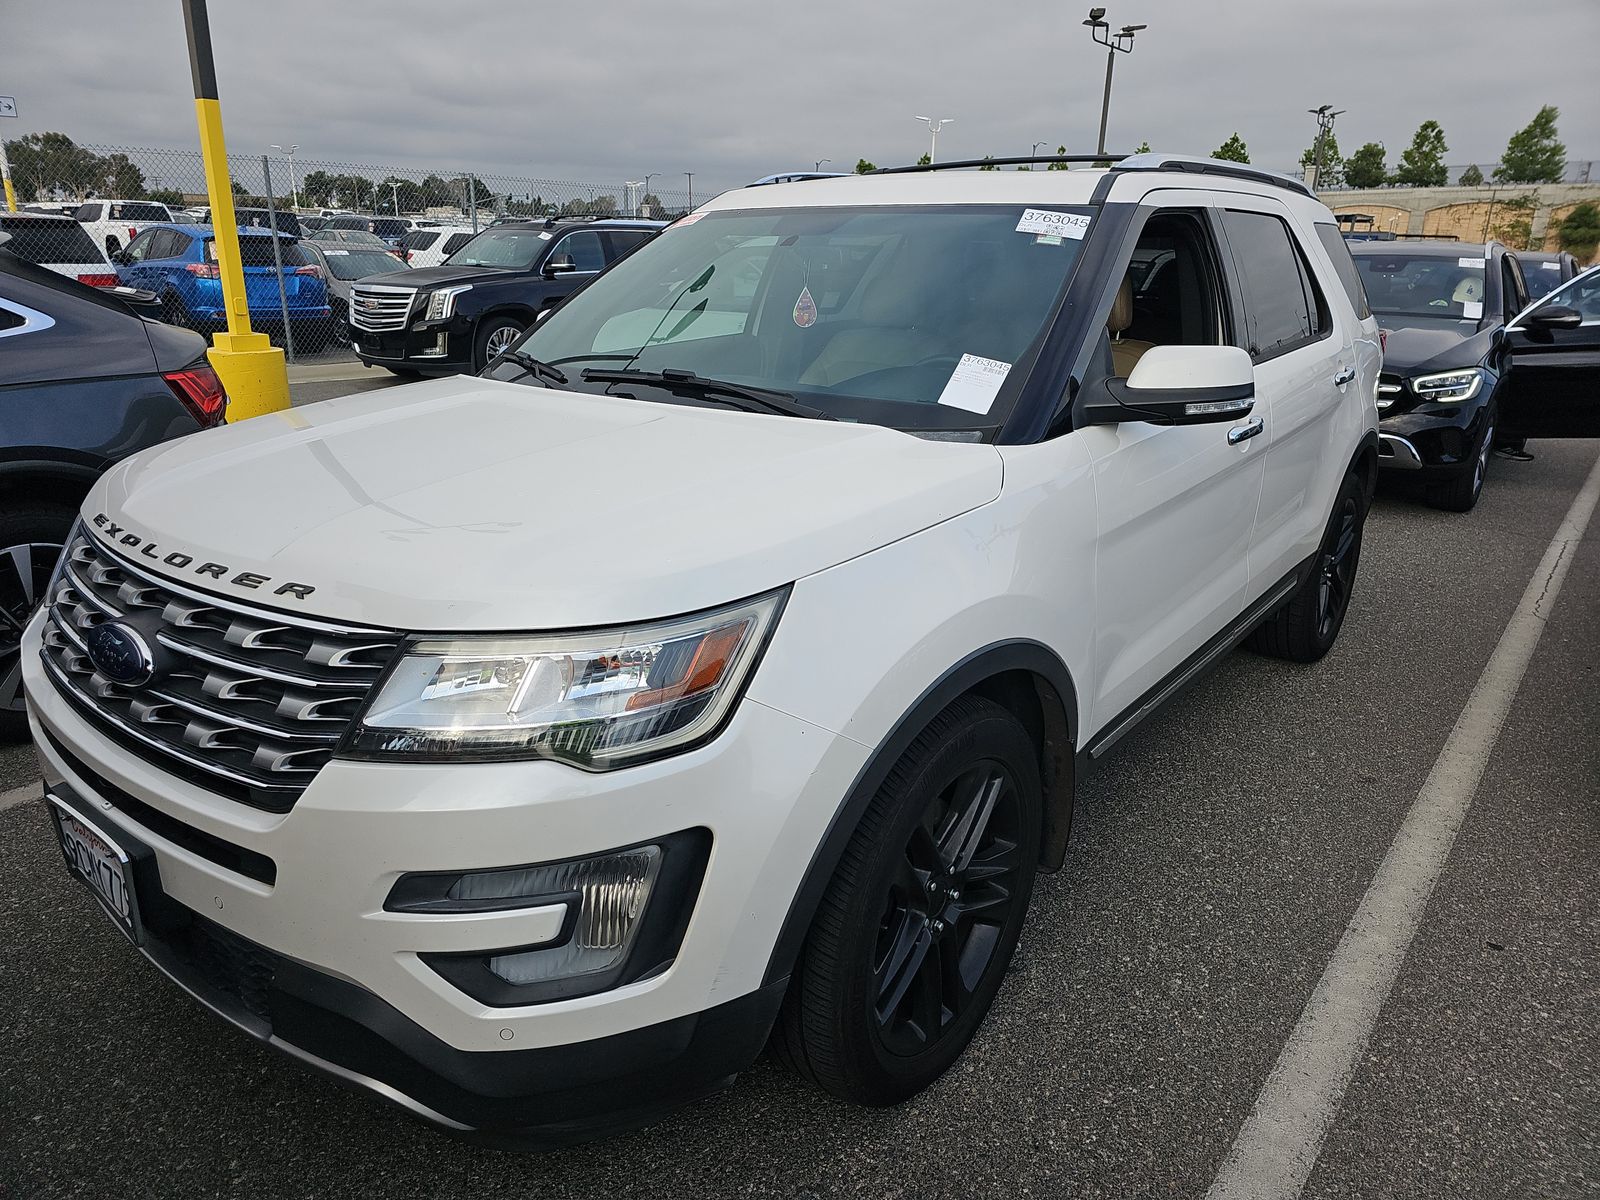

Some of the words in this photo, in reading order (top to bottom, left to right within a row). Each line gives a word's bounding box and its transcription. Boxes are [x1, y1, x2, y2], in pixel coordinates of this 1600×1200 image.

[1024, 211, 1089, 228] 3763045
[963, 355, 1011, 372] 3763045
[92, 513, 316, 600] EXPLORER
